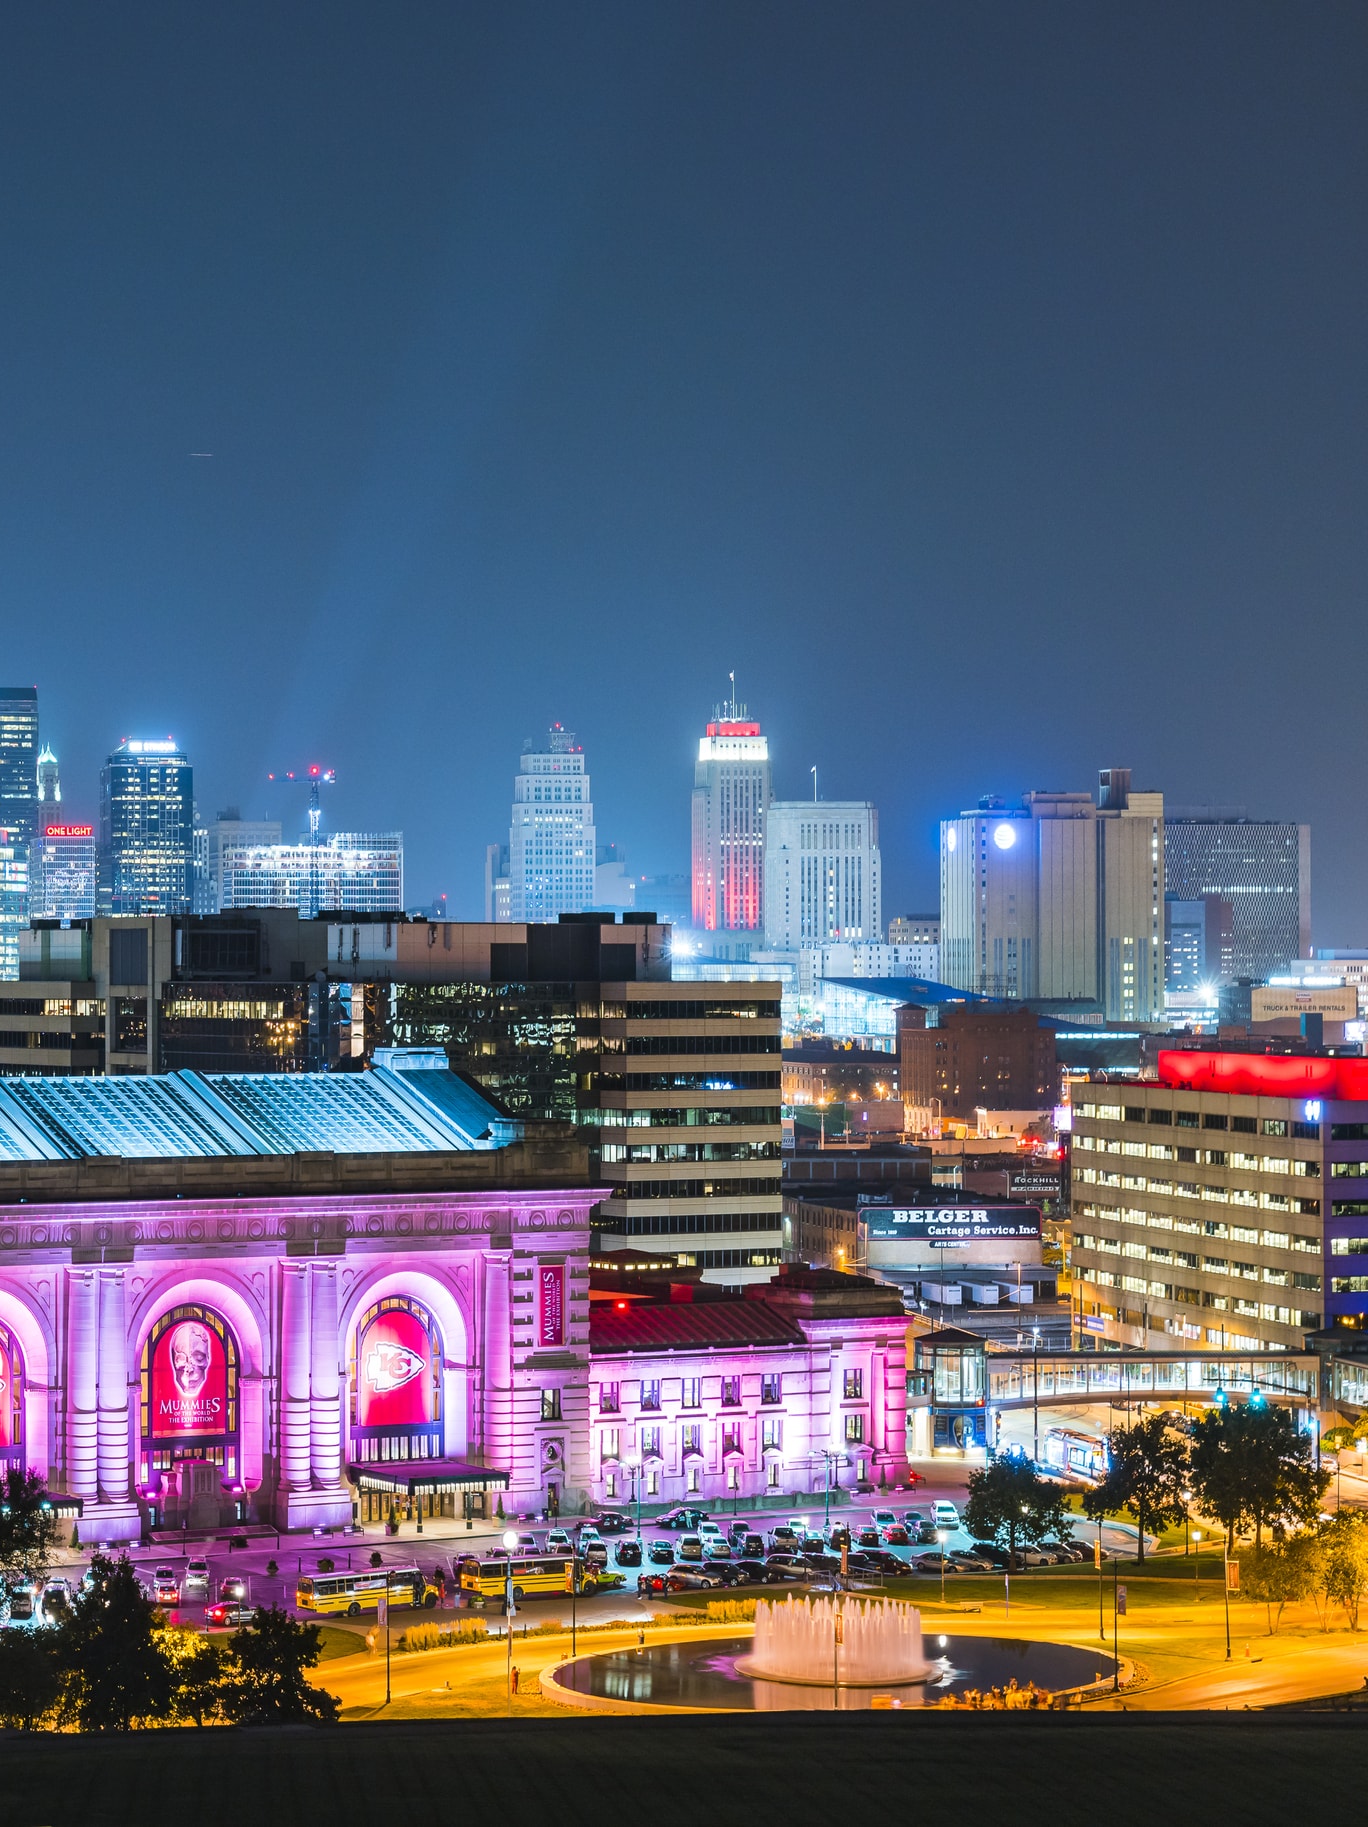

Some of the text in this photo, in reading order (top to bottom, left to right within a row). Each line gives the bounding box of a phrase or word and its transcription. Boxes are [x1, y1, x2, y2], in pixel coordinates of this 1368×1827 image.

[47, 827, 92, 836] ONE LIGHT
[893, 1209, 989, 1223] BELGER
[927, 1225, 971, 1237] Cartage
[543, 1272, 555, 1341] MUMMIES
[379, 1352, 411, 1379] KC
[159, 1397, 221, 1415] MUMMIES
